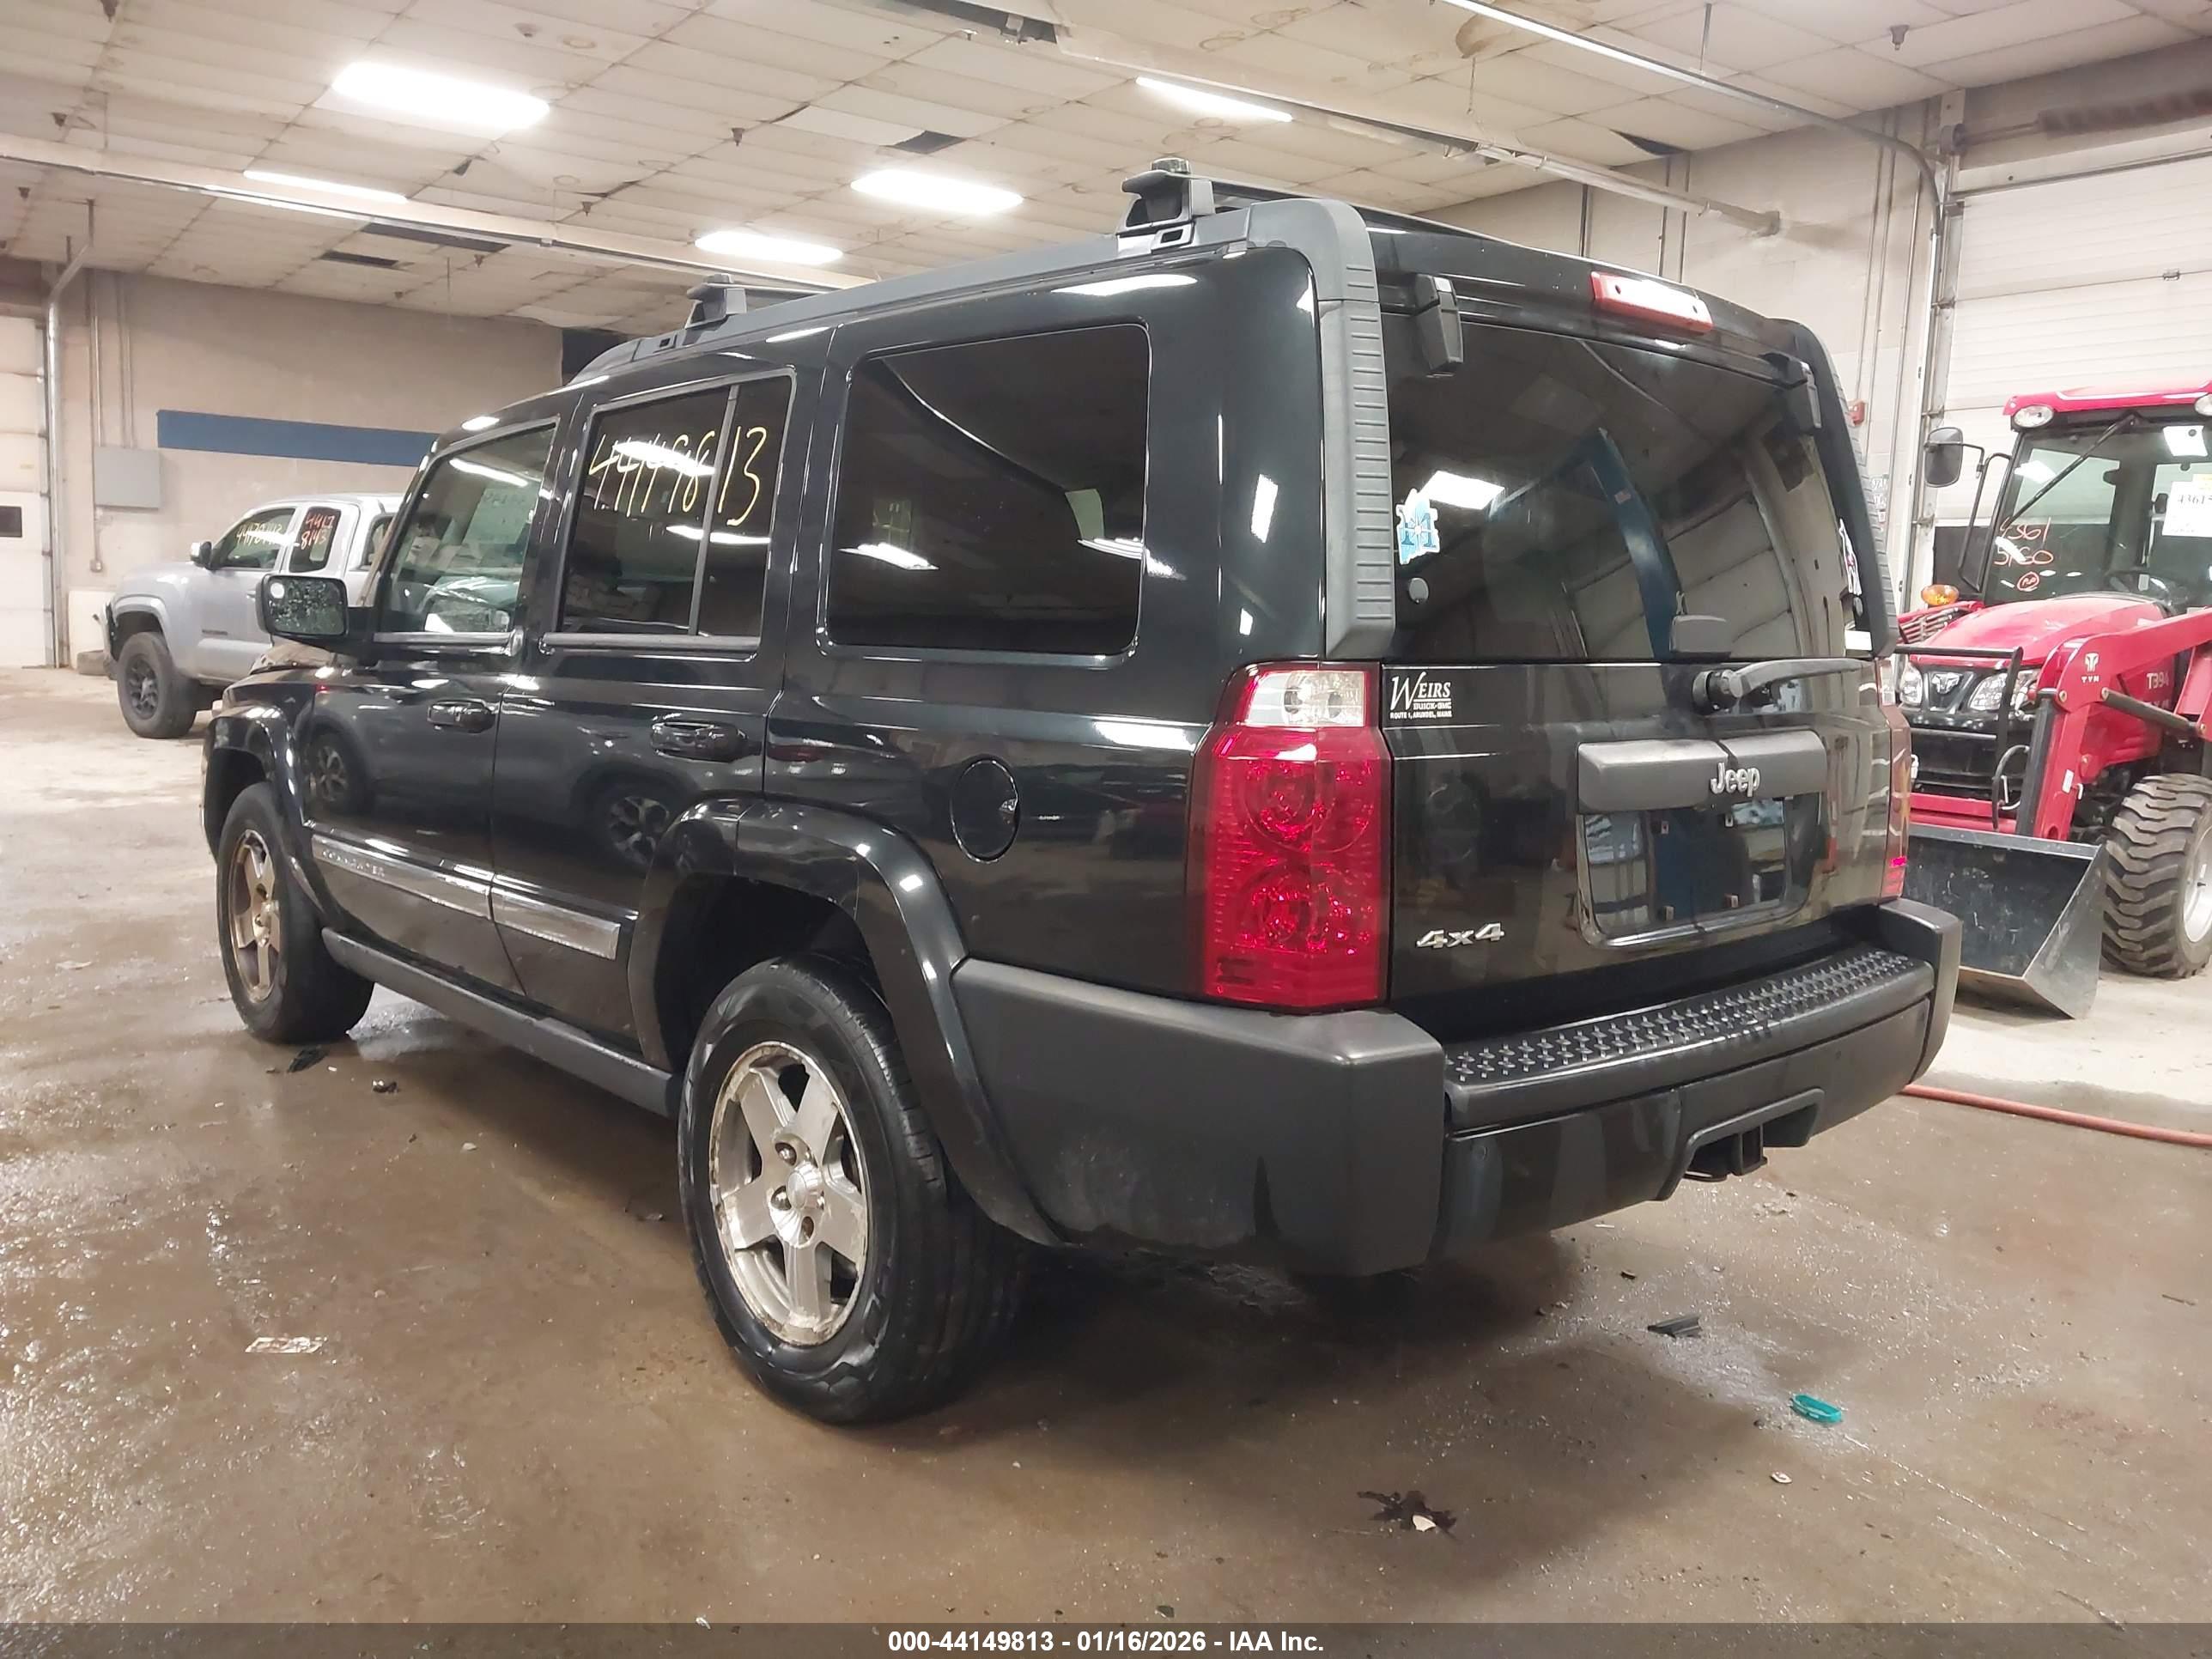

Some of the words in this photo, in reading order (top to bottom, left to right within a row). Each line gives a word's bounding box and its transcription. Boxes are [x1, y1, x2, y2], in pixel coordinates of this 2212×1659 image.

[589, 426, 767, 526] 44149813
[1390, 671, 1451, 711] WEIRS
[1710, 762, 1760, 798] Jeep
[1416, 923, 1505, 949] 4x4
